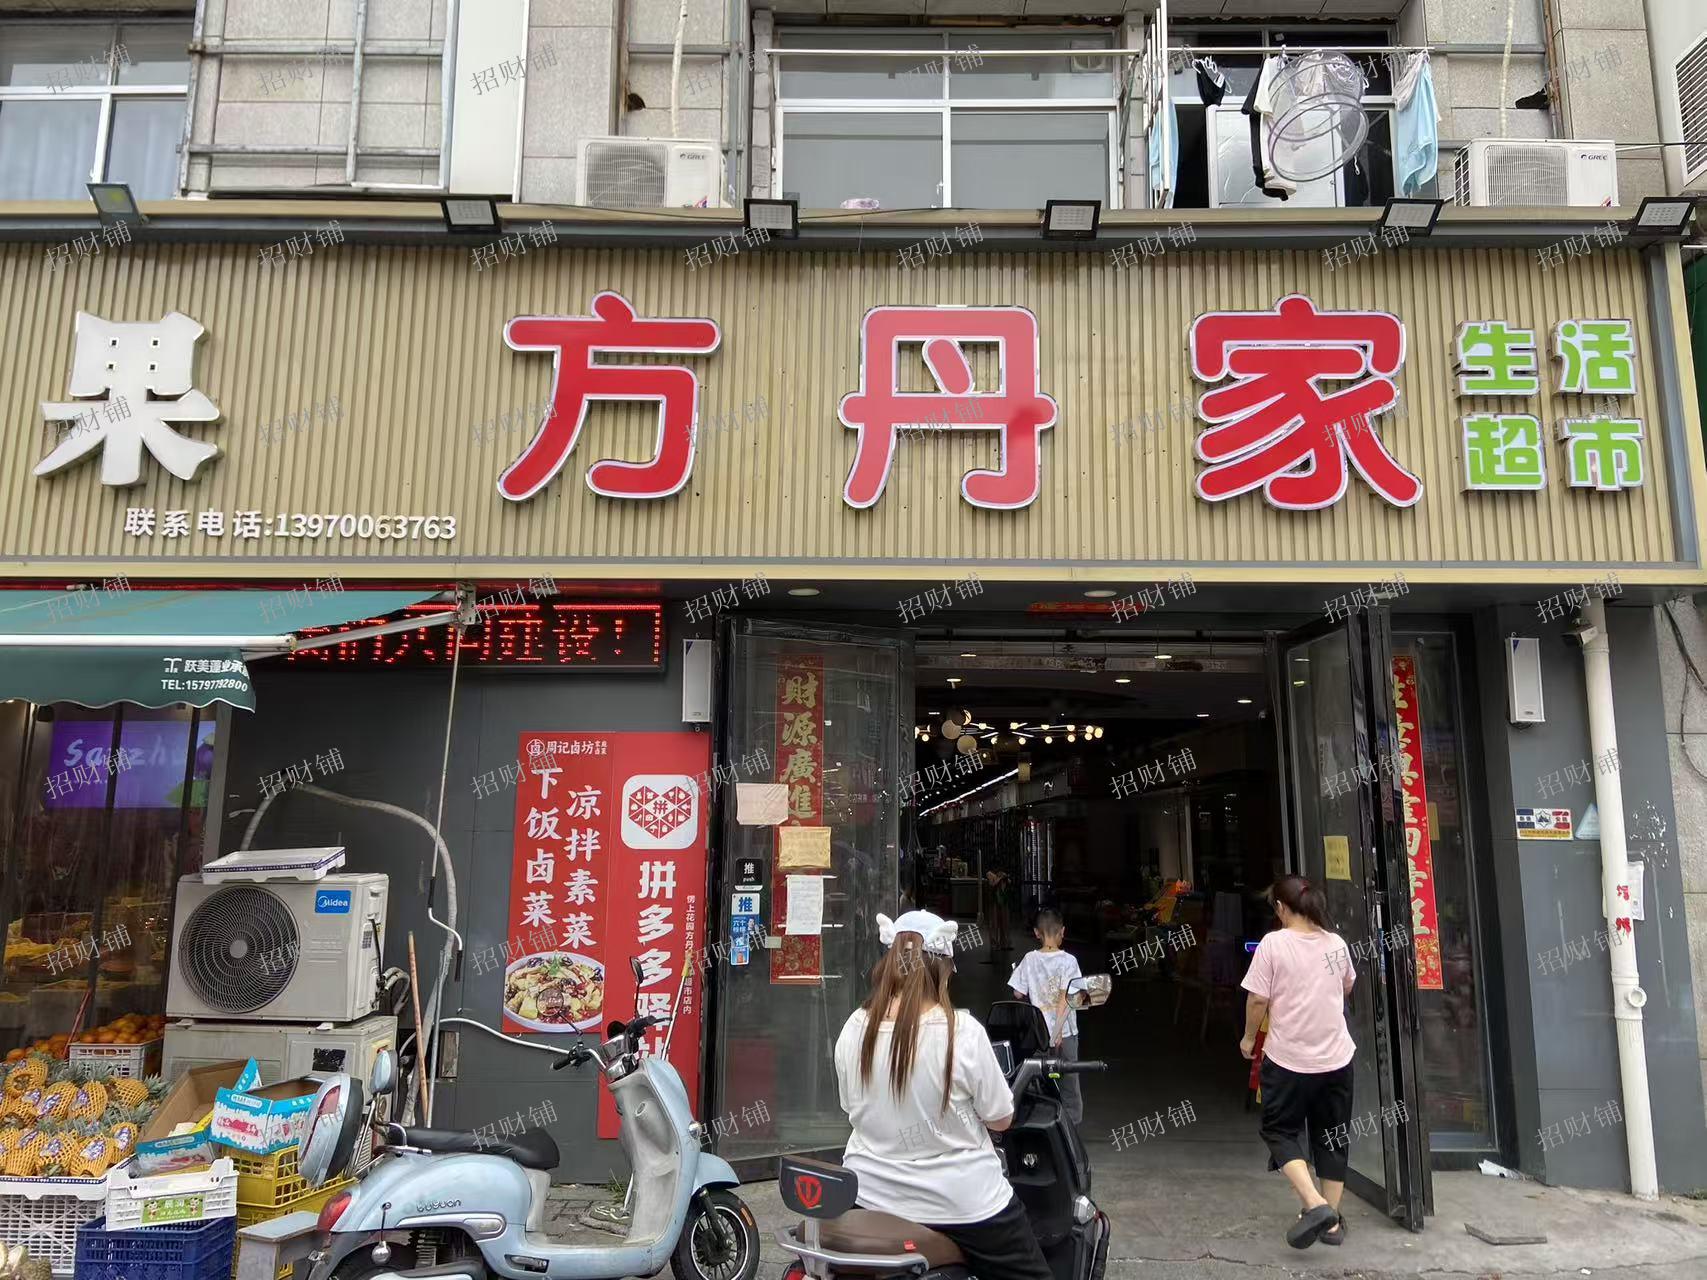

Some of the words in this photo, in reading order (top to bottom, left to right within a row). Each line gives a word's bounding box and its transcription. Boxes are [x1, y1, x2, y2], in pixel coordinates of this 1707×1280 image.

[1456, 319, 1637, 397] 生活
[33, 310, 221, 486] 果
[496, 290, 1425, 511] 方丹家
[1460, 412, 1647, 492] 超市
[124, 506, 457, 540] 联系电话:13970063763
[546, 740, 594, 755] 周记卤坊
[653, 800, 668, 815] 拼
[520, 767, 563, 927] 下饭卤菜
[559, 785, 601, 949] 凉拌素菜
[744, 862, 754, 875] 推
[318, 896, 348, 908] Midea
[738, 896, 753, 912] 推
